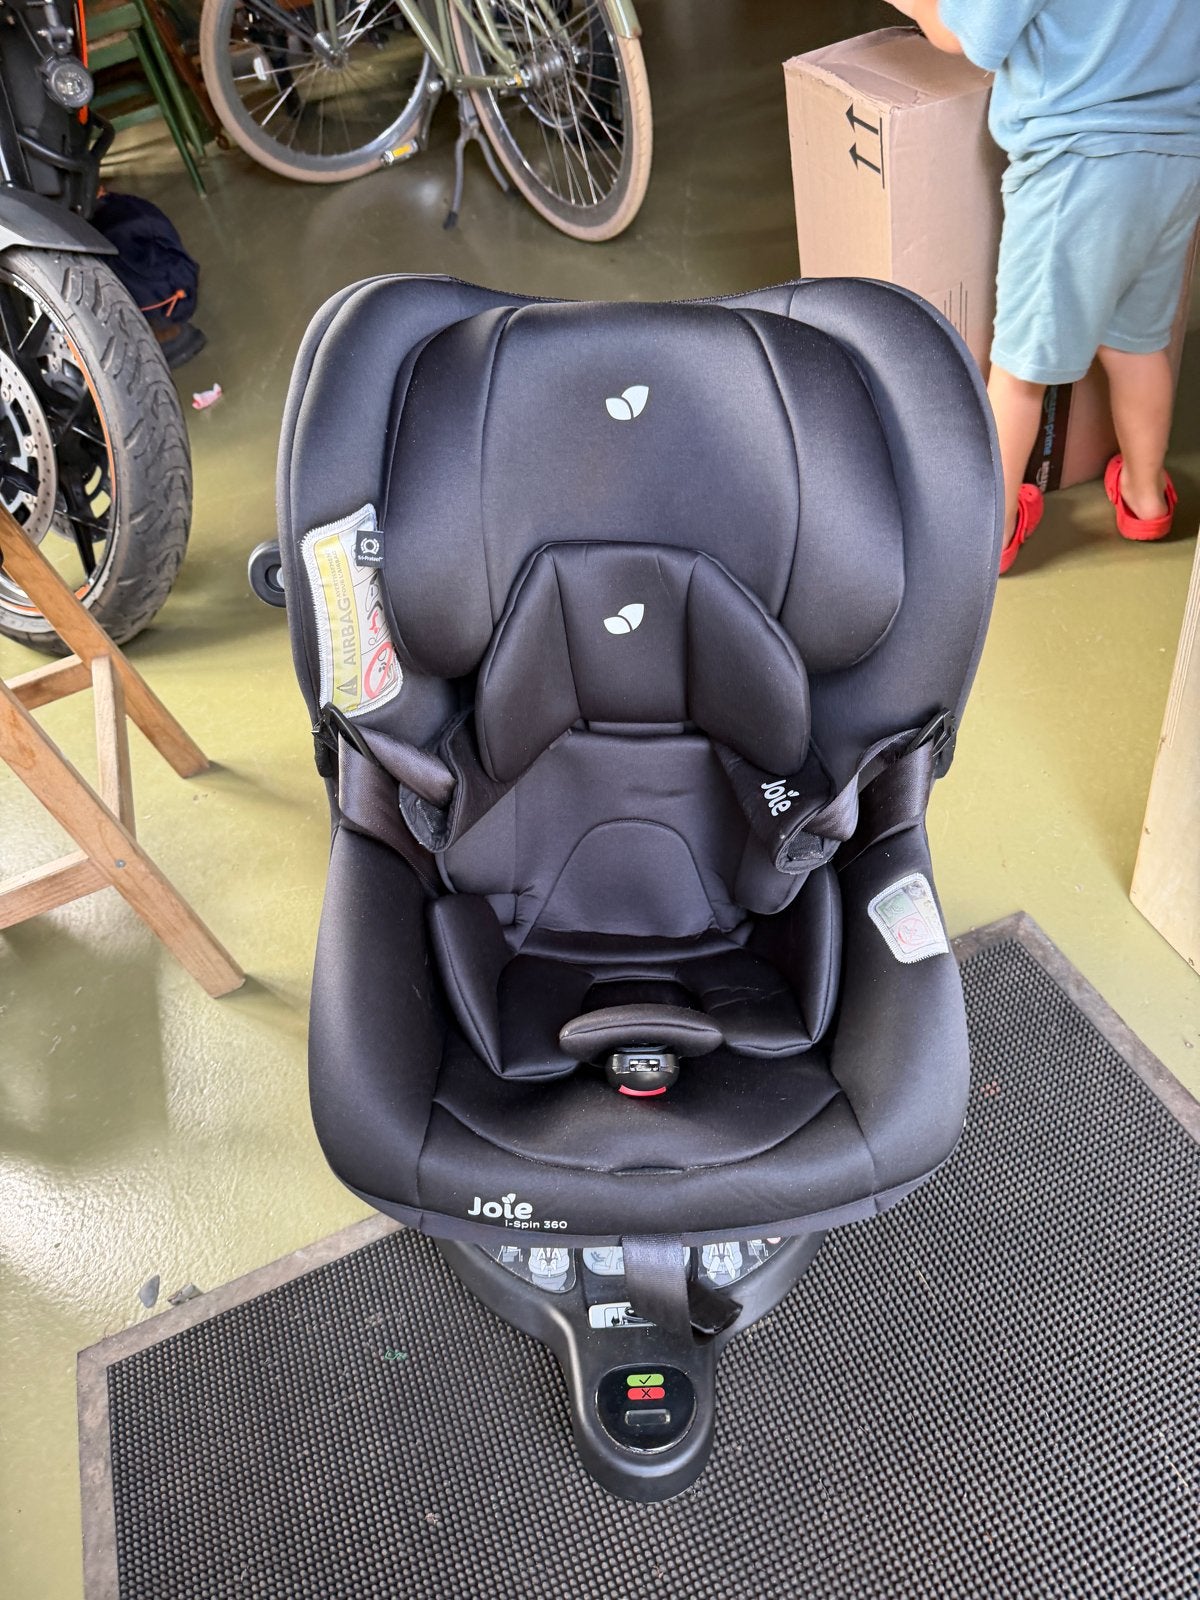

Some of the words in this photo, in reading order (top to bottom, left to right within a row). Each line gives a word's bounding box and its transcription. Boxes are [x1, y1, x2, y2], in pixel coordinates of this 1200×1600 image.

[1043, 423, 1056, 457] prime
[338, 597, 356, 665] AIRBAG
[761, 779, 800, 817] Joie
[467, 1193, 533, 1220] Joie
[543, 1220, 568, 1230] 360
